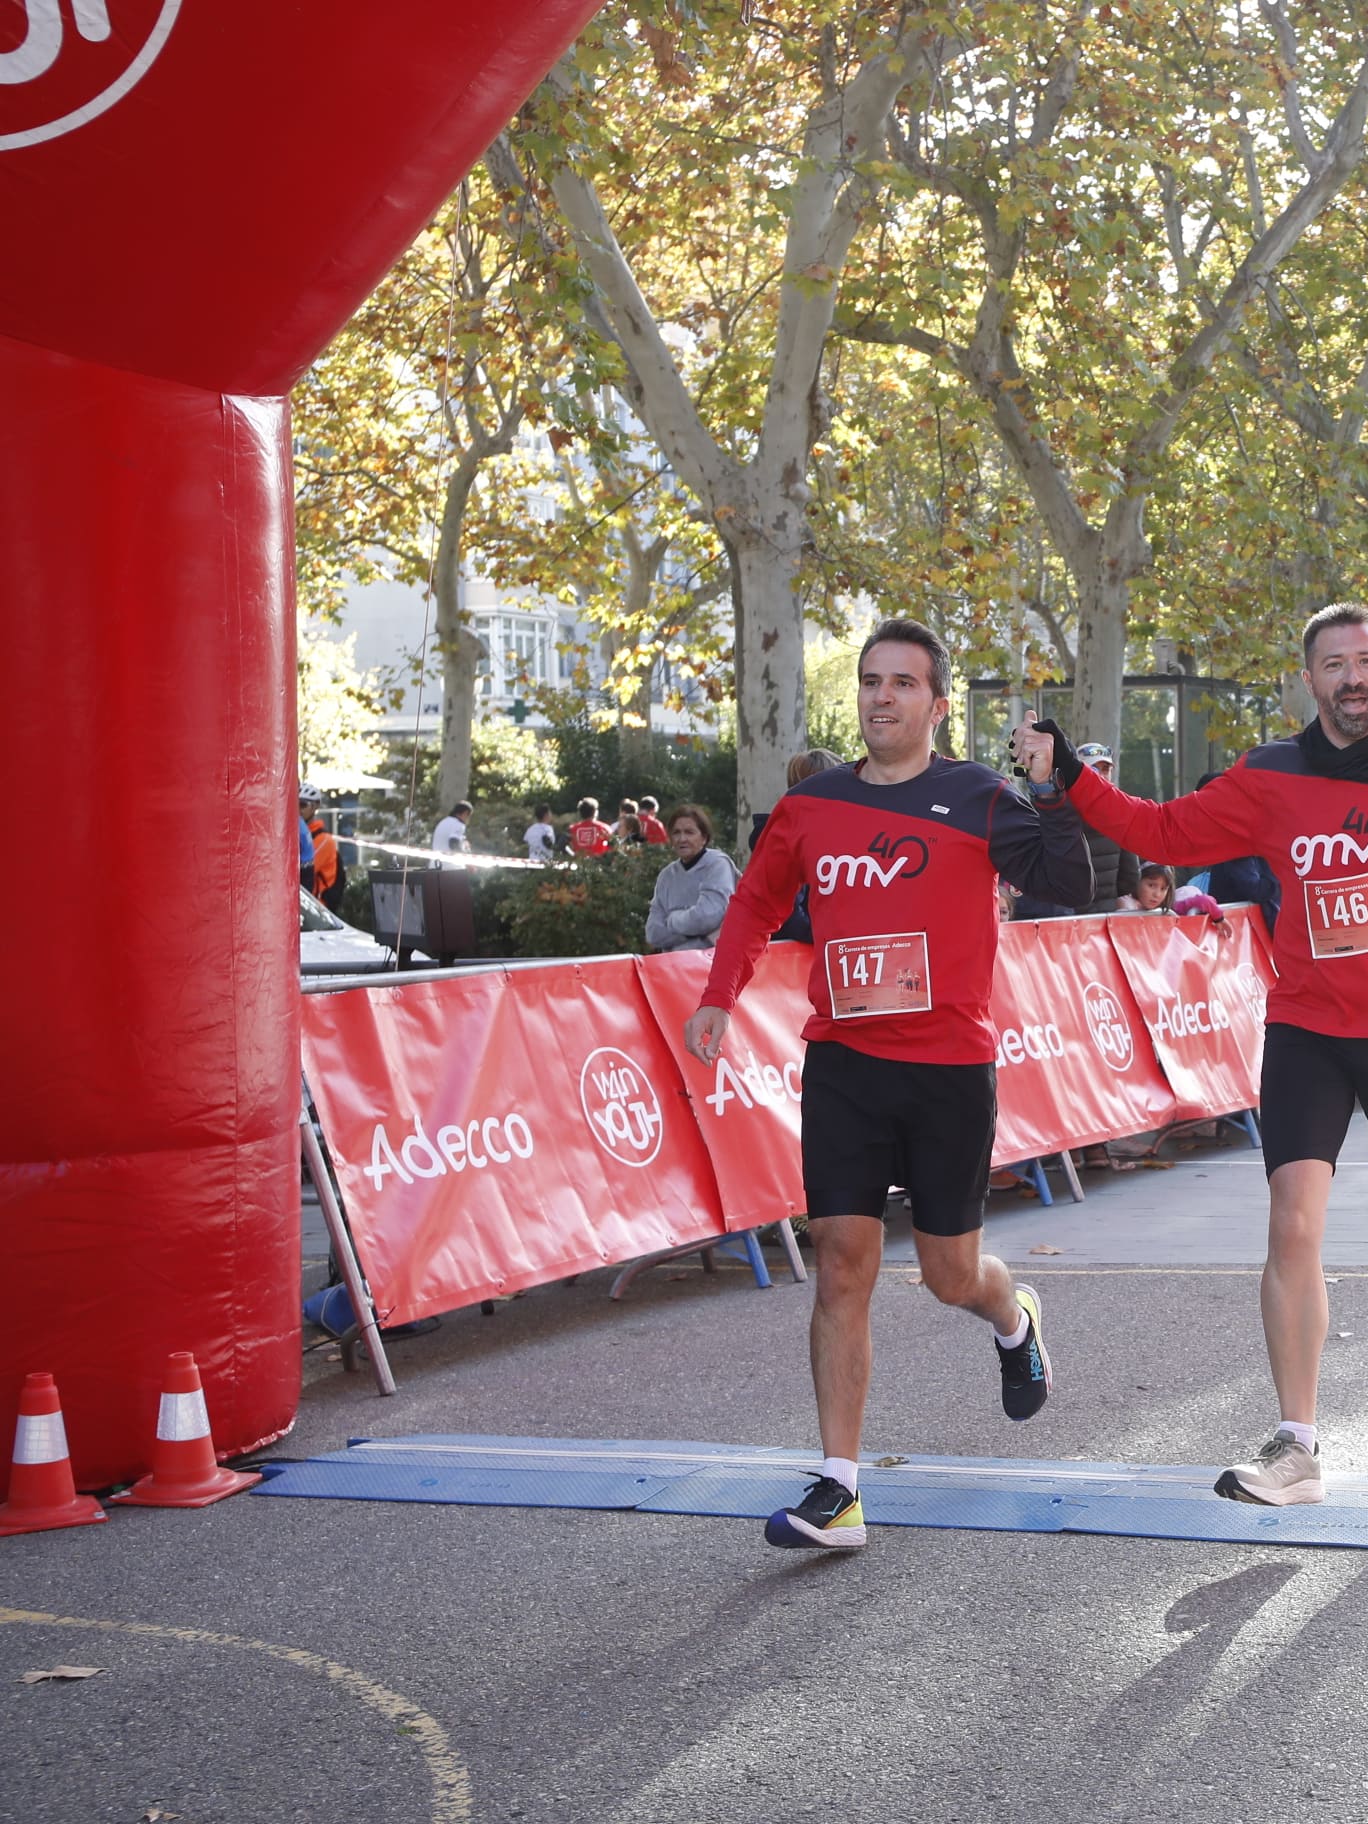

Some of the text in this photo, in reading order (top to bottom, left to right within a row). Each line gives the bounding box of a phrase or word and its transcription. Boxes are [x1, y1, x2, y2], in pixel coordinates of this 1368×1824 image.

[816, 854, 908, 895] gmv
[1316, 892, 1368, 929] 146
[839, 952, 884, 988] 147
[1154, 991, 1230, 1041] Adecco
[363, 1112, 534, 1192] Adecco
